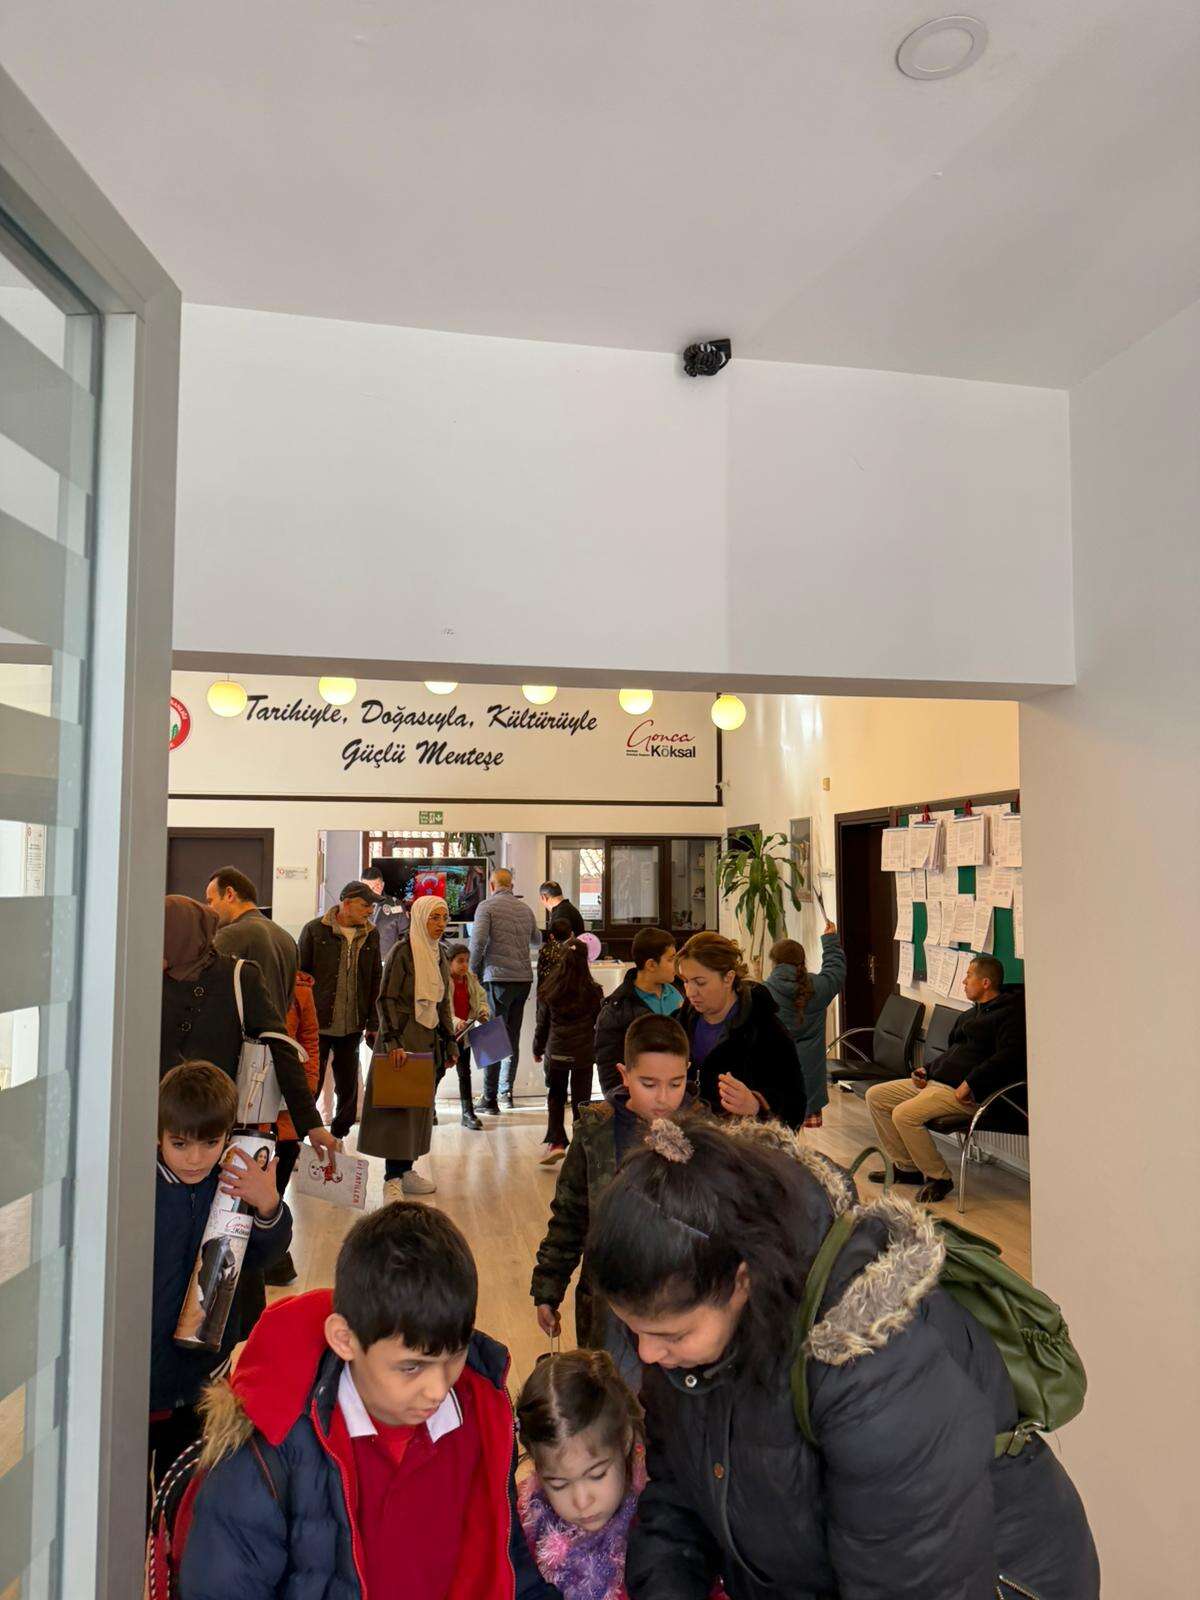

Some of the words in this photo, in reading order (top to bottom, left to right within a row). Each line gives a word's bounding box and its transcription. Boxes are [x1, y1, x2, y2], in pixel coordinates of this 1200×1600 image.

[246, 694, 348, 729] Tarihiyle,
[361, 699, 474, 733] Doğasıyla,
[486, 703, 598, 737] Kültürüyle
[626, 720, 696, 753] Gonca
[650, 744, 697, 759] Köksal
[341, 738, 406, 771] Güçlü
[415, 739, 504, 771] Menteşe
